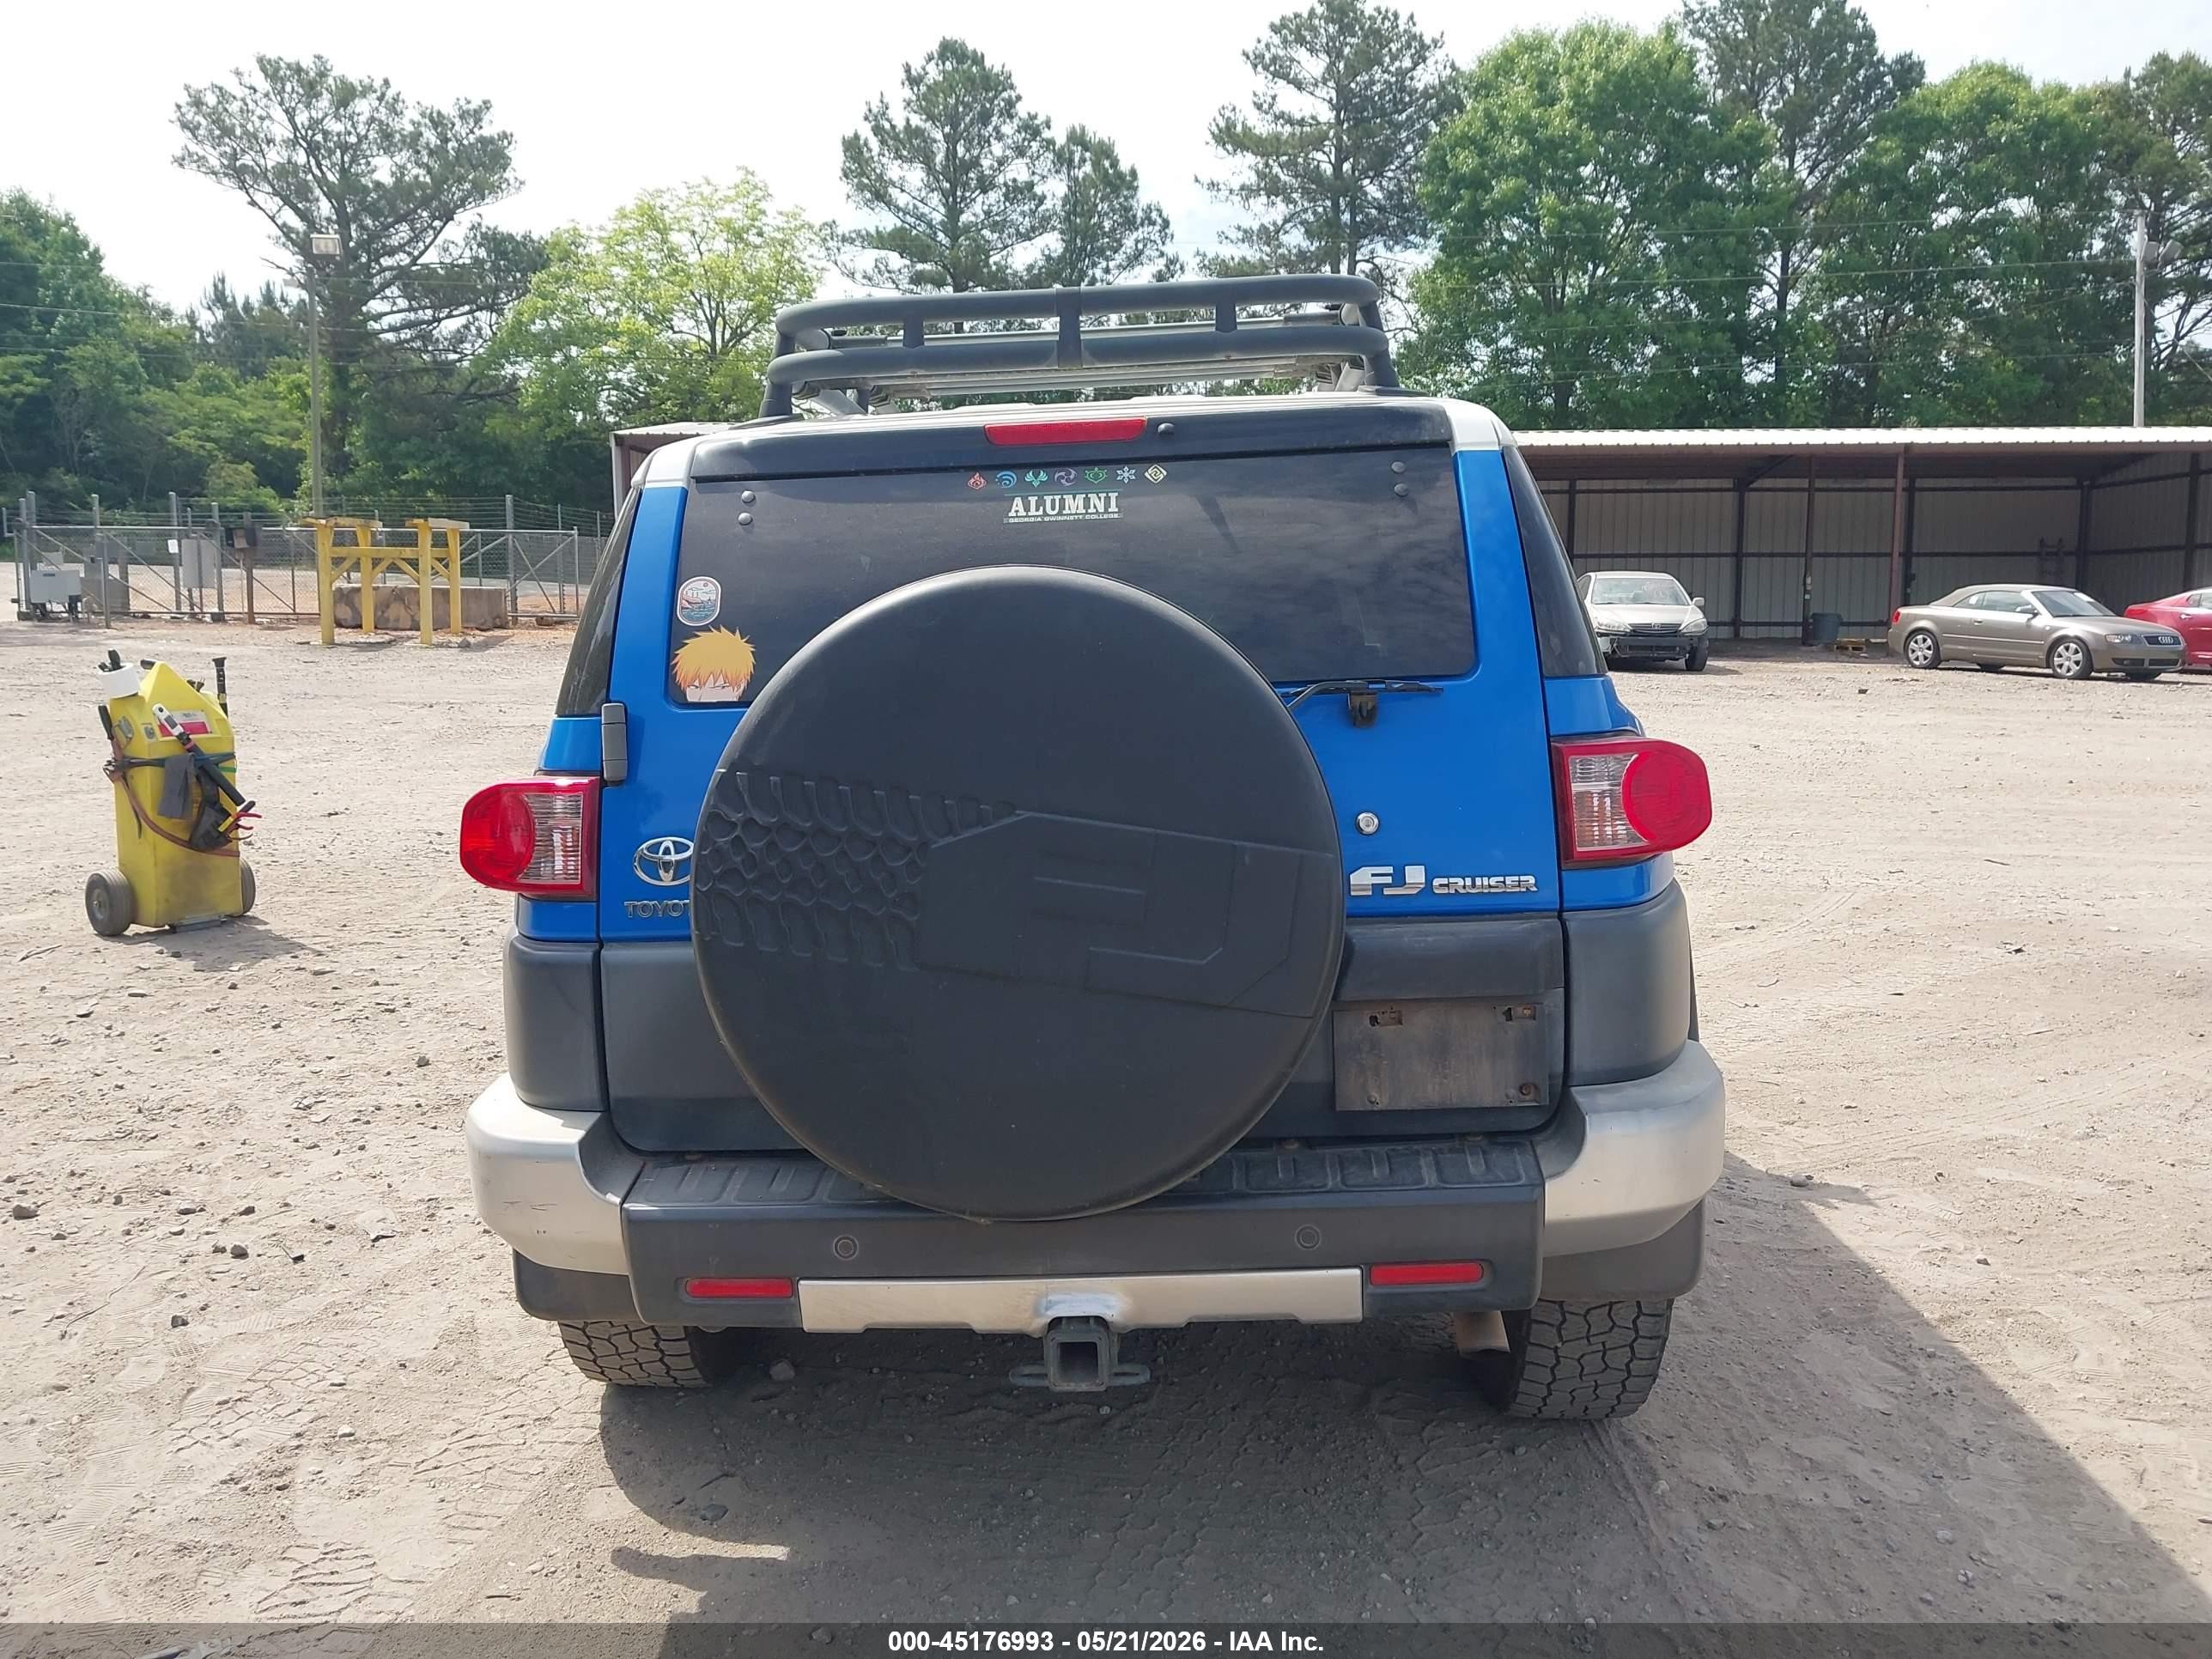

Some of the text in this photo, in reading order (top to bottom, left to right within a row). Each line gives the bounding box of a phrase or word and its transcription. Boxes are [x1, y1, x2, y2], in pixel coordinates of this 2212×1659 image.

[1008, 492, 1119, 517] ALUMNI
[1350, 866, 1539, 896] FJ CRUISER
